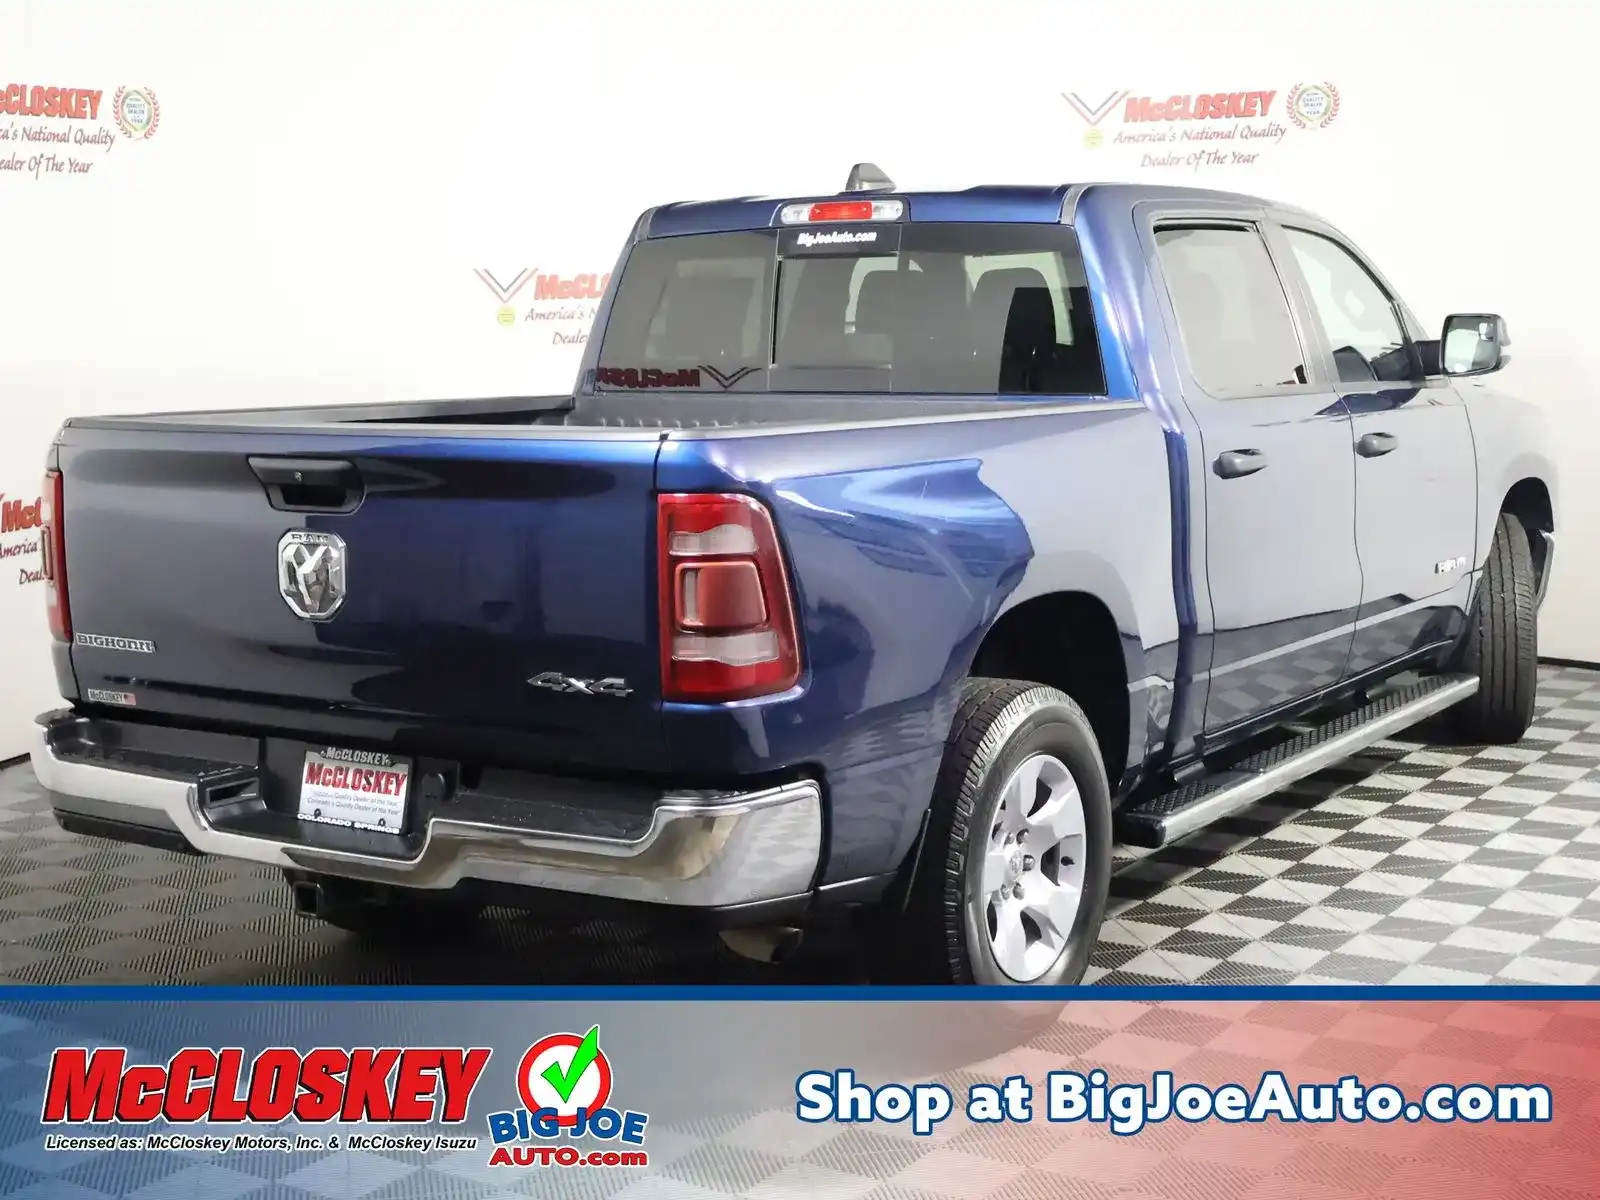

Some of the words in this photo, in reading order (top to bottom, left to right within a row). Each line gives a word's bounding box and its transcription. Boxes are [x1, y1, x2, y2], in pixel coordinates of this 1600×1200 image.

[1123, 90, 1277, 124] McCLOSKEY
[21, 125, 71, 145] National
[74, 128, 116, 153] Quality
[1113, 127, 1177, 144] America's
[1180, 125, 1236, 142] National
[1239, 122, 1286, 145] Quality
[0, 152, 26, 172] ealer
[28, 153, 44, 181] Of
[45, 154, 65, 173] The
[68, 156, 94, 174] Year
[1140, 151, 1184, 168] Dealer
[1186, 149, 1206, 173] Of
[1205, 149, 1228, 166] The
[1231, 149, 1259, 166] Year
[797, 231, 877, 247] BigJoeAuto.com
[525, 305, 584, 322] America's
[291, 533, 329, 543] RAM
[19, 566, 44, 585] Deal
[76, 632, 154, 654] BIGHORN
[326, 747, 388, 766] McCLOSKEY
[305, 762, 407, 796] McCLOSKEY
[297, 813, 352, 827] COLORADO
[354, 821, 400, 835] SPRINGS
